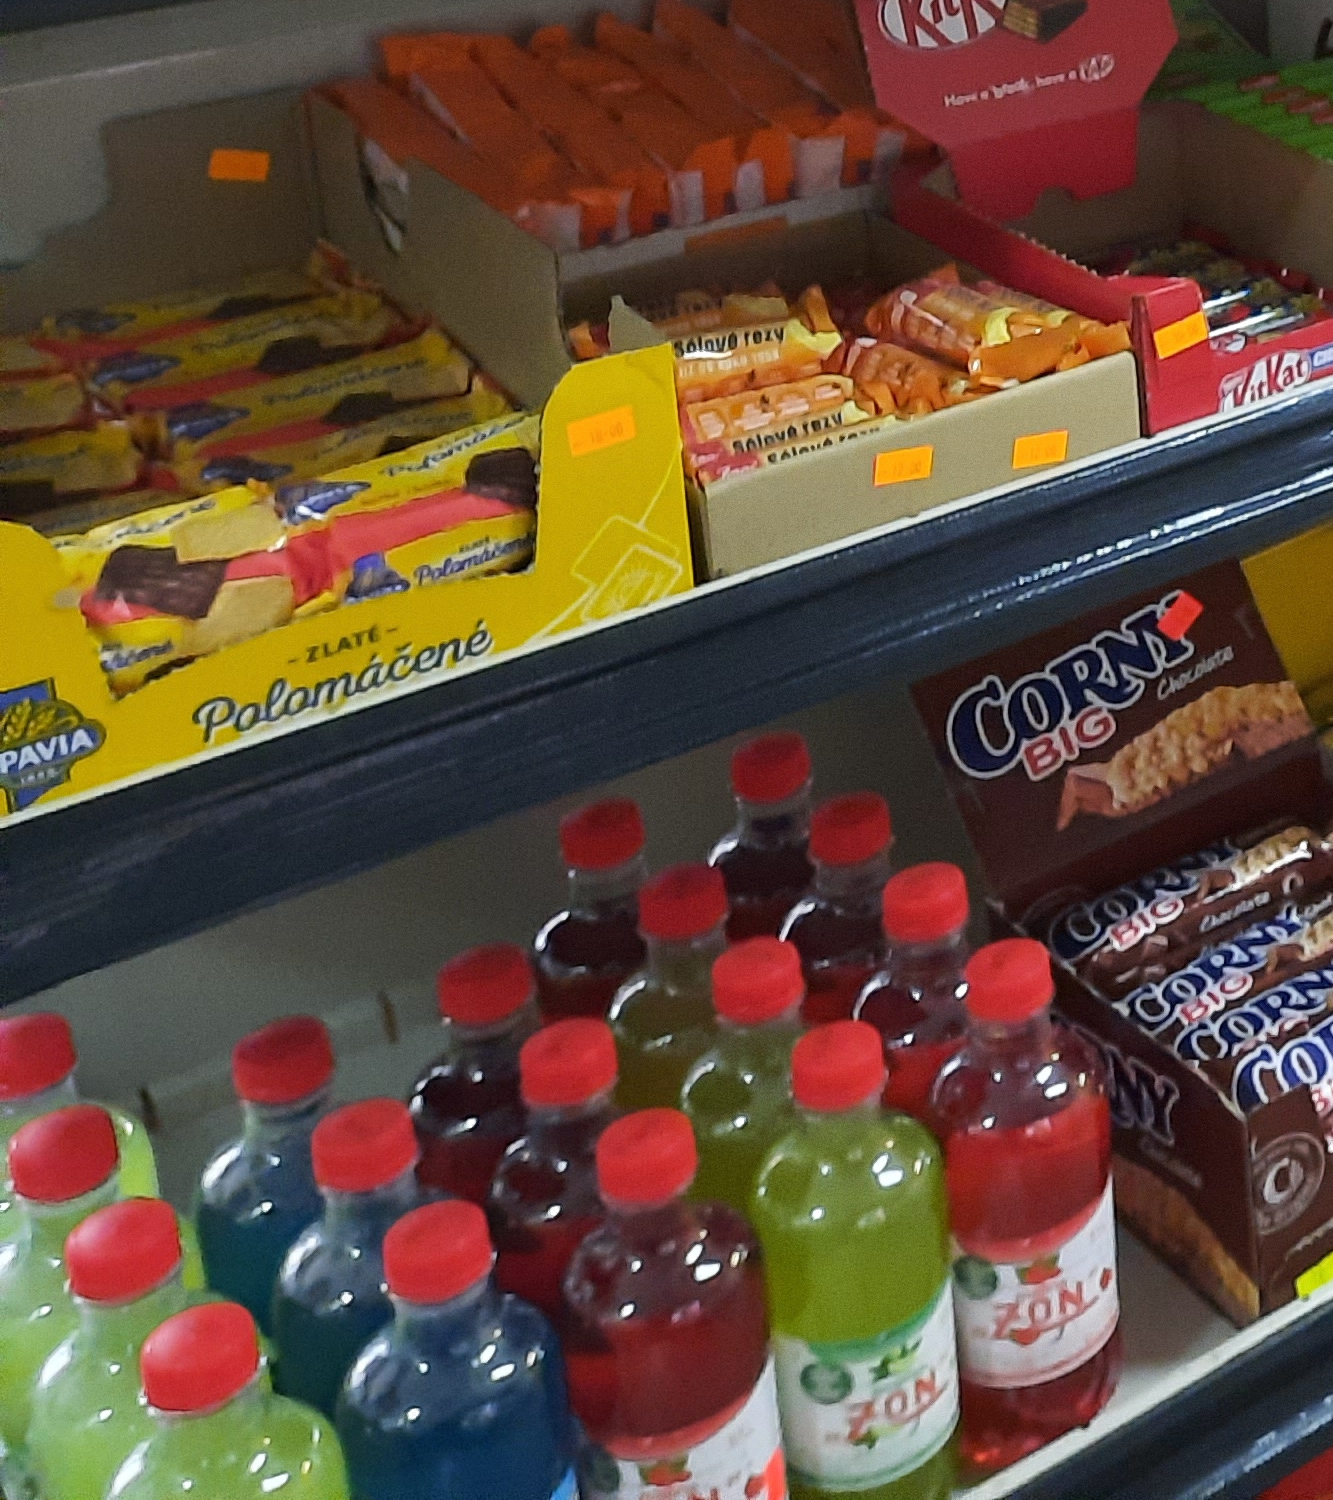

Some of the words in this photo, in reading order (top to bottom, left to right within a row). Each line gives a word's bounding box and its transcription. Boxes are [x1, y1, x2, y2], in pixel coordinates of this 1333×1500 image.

[306, 625, 380, 662] ZLATÉ
[192, 620, 493, 744] Polomáčené
[1157, 647, 1233, 701] Chocolate
[0, 729, 95, 772] PAVIA
[1021, 706, 1116, 781] BIG
[1108, 898, 1184, 949] BIG
[1129, 906, 1302, 1030] CORNY
[1181, 972, 1253, 1024] BIG
